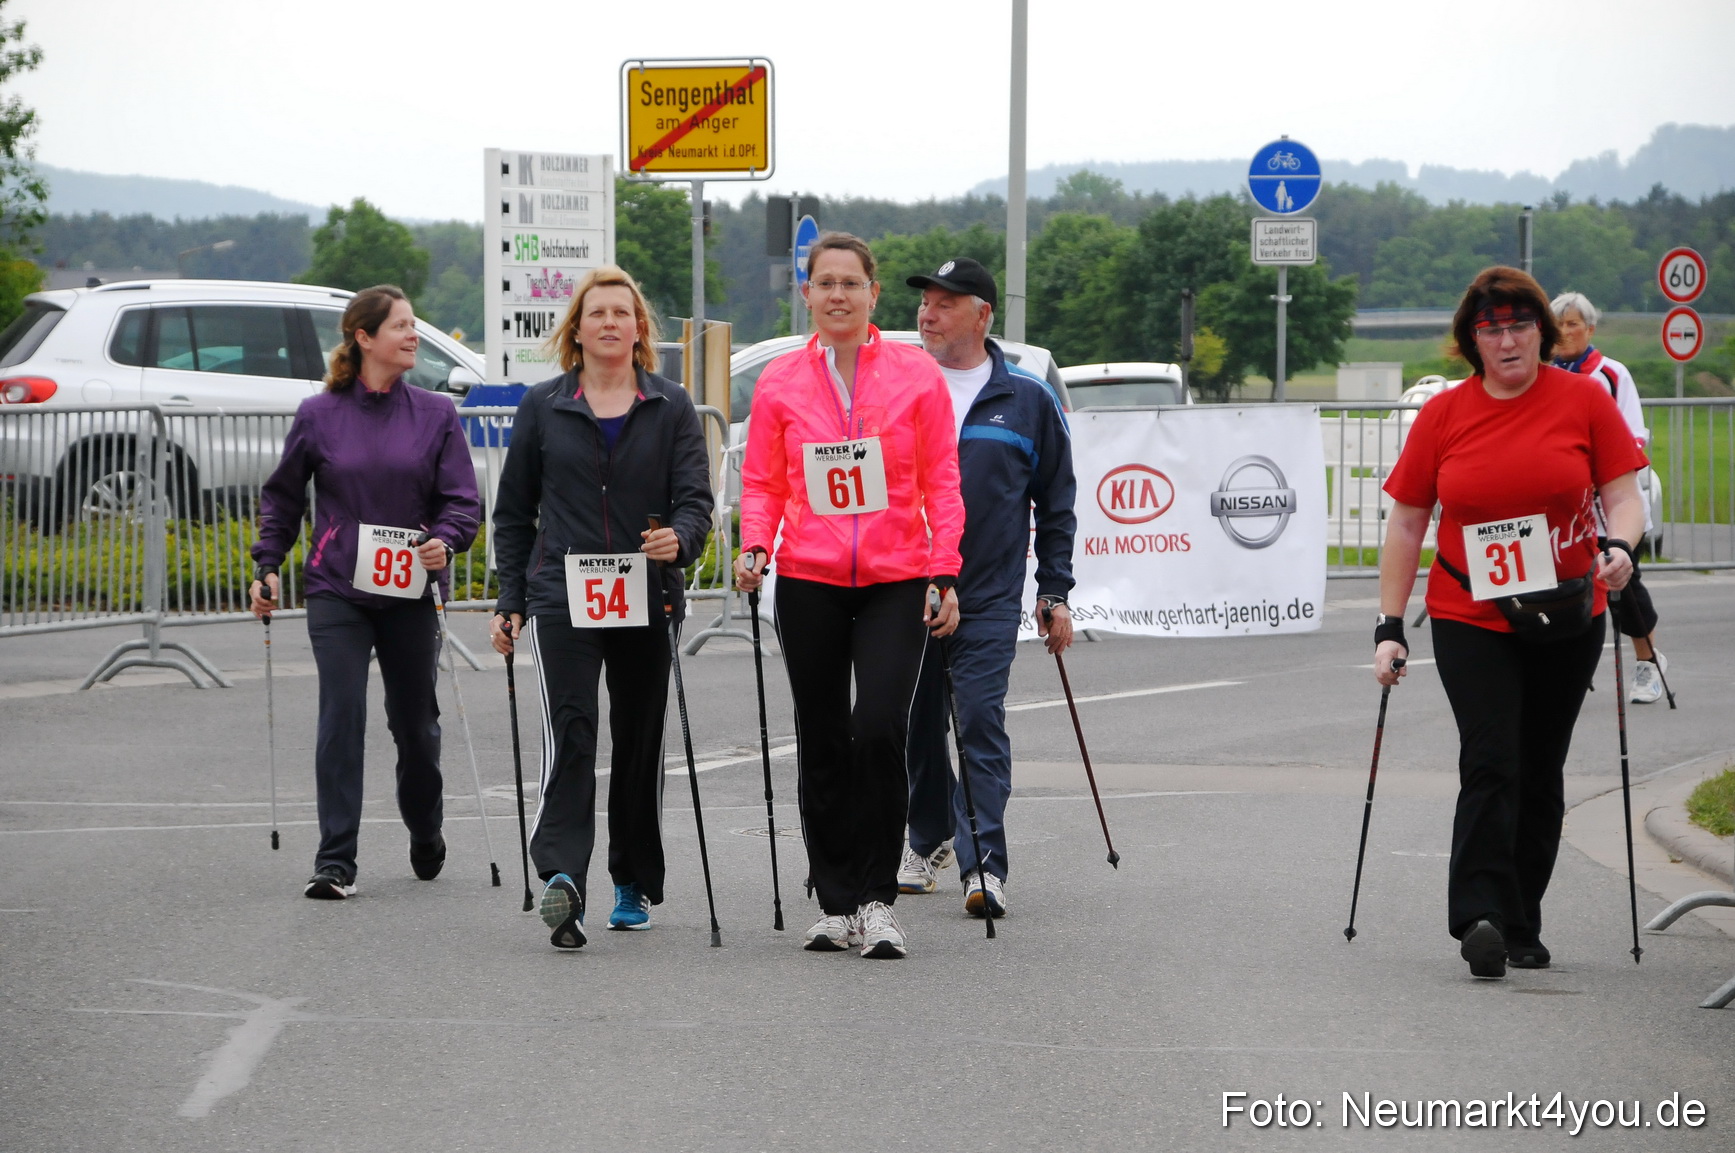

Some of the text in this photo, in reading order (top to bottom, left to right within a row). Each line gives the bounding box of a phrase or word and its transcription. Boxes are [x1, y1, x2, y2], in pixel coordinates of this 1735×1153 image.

[640, 79, 754, 113] Sengenthal
[656, 114, 739, 133] am Anger
[637, 143, 759, 159] Kreis Neumarkt i.d.OPf.
[540, 154, 589, 173] HOLZAMMER
[540, 193, 589, 211] HOLZAMMER
[1263, 224, 1305, 235] Landwirt-
[514, 233, 589, 262] SHB Holzfachmarkt
[1259, 236, 1309, 246] schaftlicher
[1259, 247, 1310, 258] Verkehr frei
[1669, 263, 1696, 288] 60
[814, 445, 850, 456] MEYER
[814, 453, 852, 462] WERBUNG
[827, 465, 866, 510] 61
[1110, 478, 1161, 510] KIA
[1220, 494, 1288, 511] NISSAN
[372, 528, 405, 539] MEYER
[1477, 522, 1516, 537] MEYER
[1478, 531, 1518, 542] WERBUNG
[371, 536, 405, 546] WERBUNG
[1085, 533, 1192, 556] KIA MOTORS
[372, 546, 413, 589] 93
[579, 557, 616, 568] MEYER
[579, 566, 616, 574] WERBUNG
[1485, 540, 1528, 587] 31
[585, 577, 629, 621] 54
[1115, 597, 1315, 632] www.gerhart-jaenig.de
